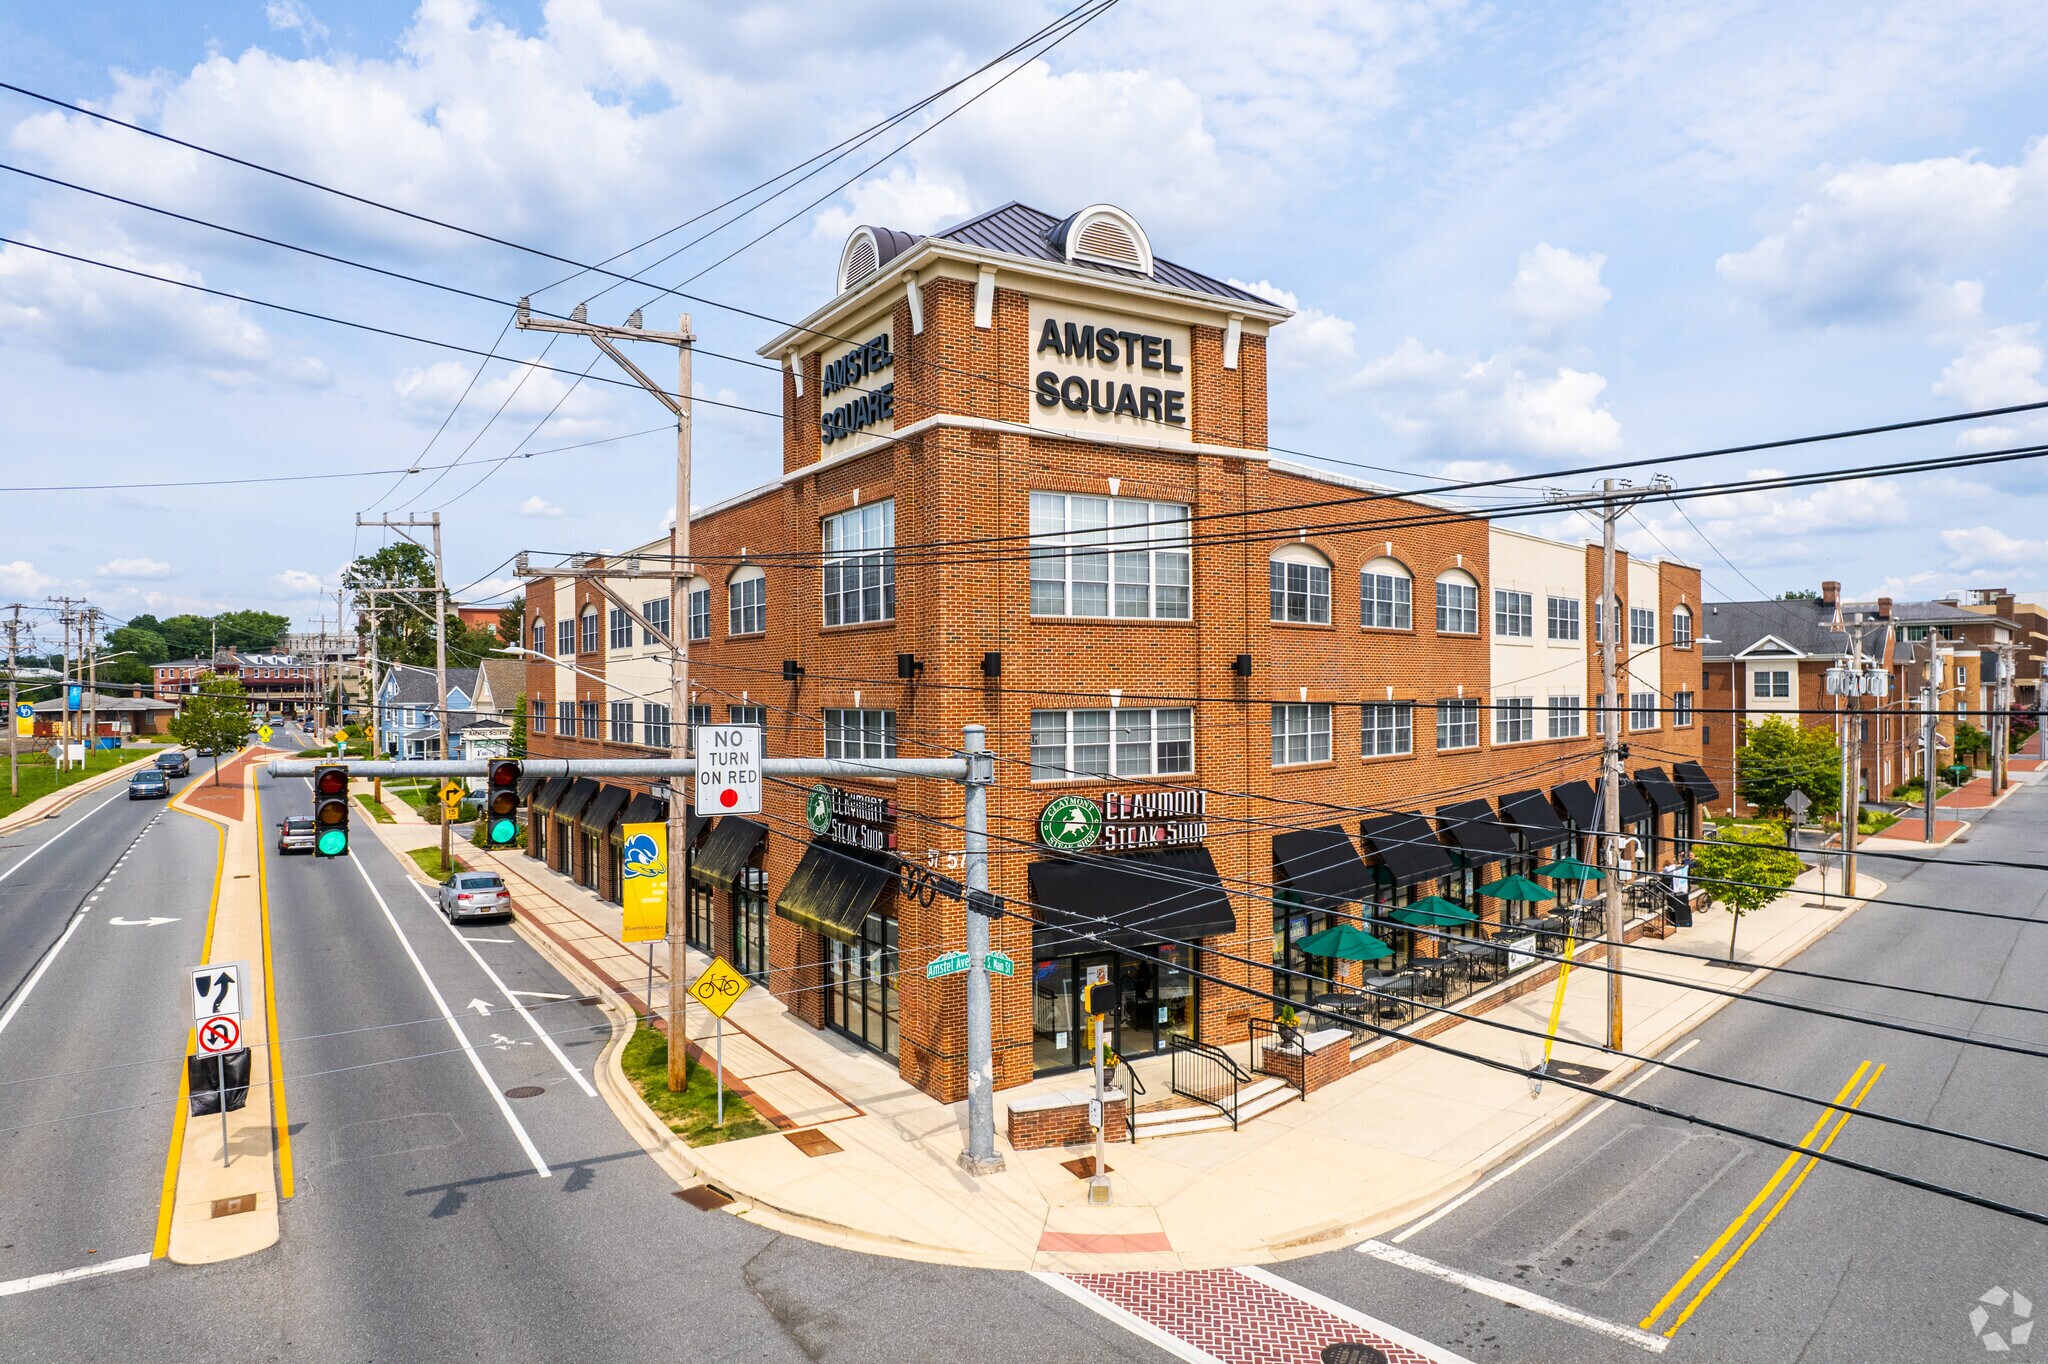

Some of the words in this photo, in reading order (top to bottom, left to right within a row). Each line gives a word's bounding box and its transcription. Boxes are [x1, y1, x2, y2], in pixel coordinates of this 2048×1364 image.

[1037, 318, 1183, 373] AMSTEL
[822, 333, 894, 397] AMSTEL
[1036, 371, 1185, 423] SQUARE
[822, 383, 894, 444] SQUARE
[715, 731, 742, 747] NO
[709, 752, 749, 766] TURN
[701, 771, 721, 785] ON
[728, 770, 757, 784] RED
[832, 787, 883, 823] CLAYMONT
[1047, 797, 1095, 817] CLAYMONT
[1106, 790, 1208, 820] CLAYMONT
[832, 818, 858, 846] STEAK
[861, 824, 884, 850] SHOP
[1077, 830, 1095, 848] SHOP
[1105, 825, 1159, 851] STEAK
[1167, 820, 1208, 845] SHOP
[624, 924, 664, 932] BlueHens.com
[928, 957, 954, 976] Amstel
[956, 957, 969, 970] Ave
[1005, 961, 1011, 974] St
